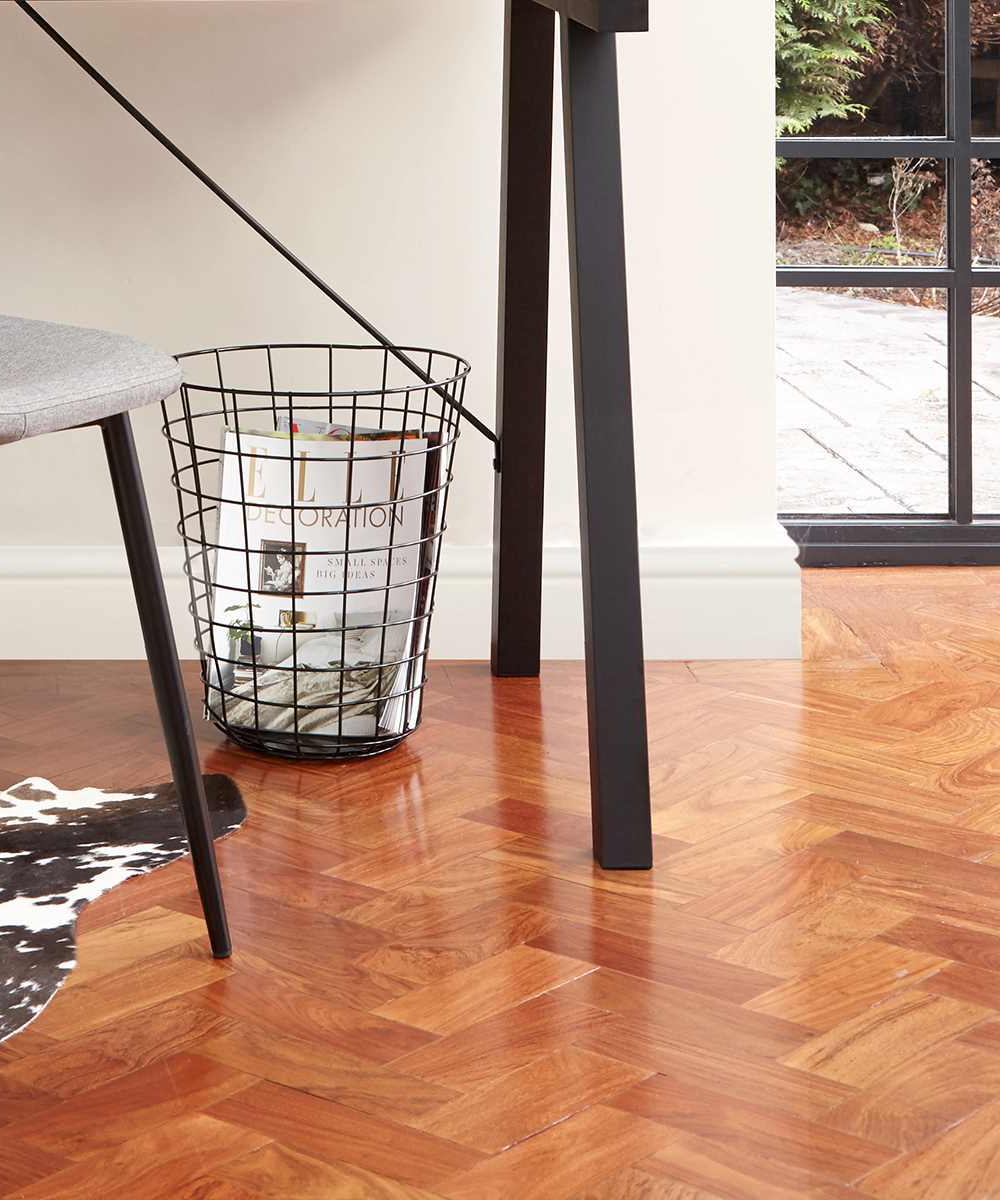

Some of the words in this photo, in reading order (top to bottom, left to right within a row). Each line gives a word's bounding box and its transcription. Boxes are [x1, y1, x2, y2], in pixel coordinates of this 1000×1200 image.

[247, 445, 406, 504] ELLE
[246, 502, 404, 528] DECORATION
[327, 557, 367, 567] SMALL
[316, 569, 337, 579] BIG
